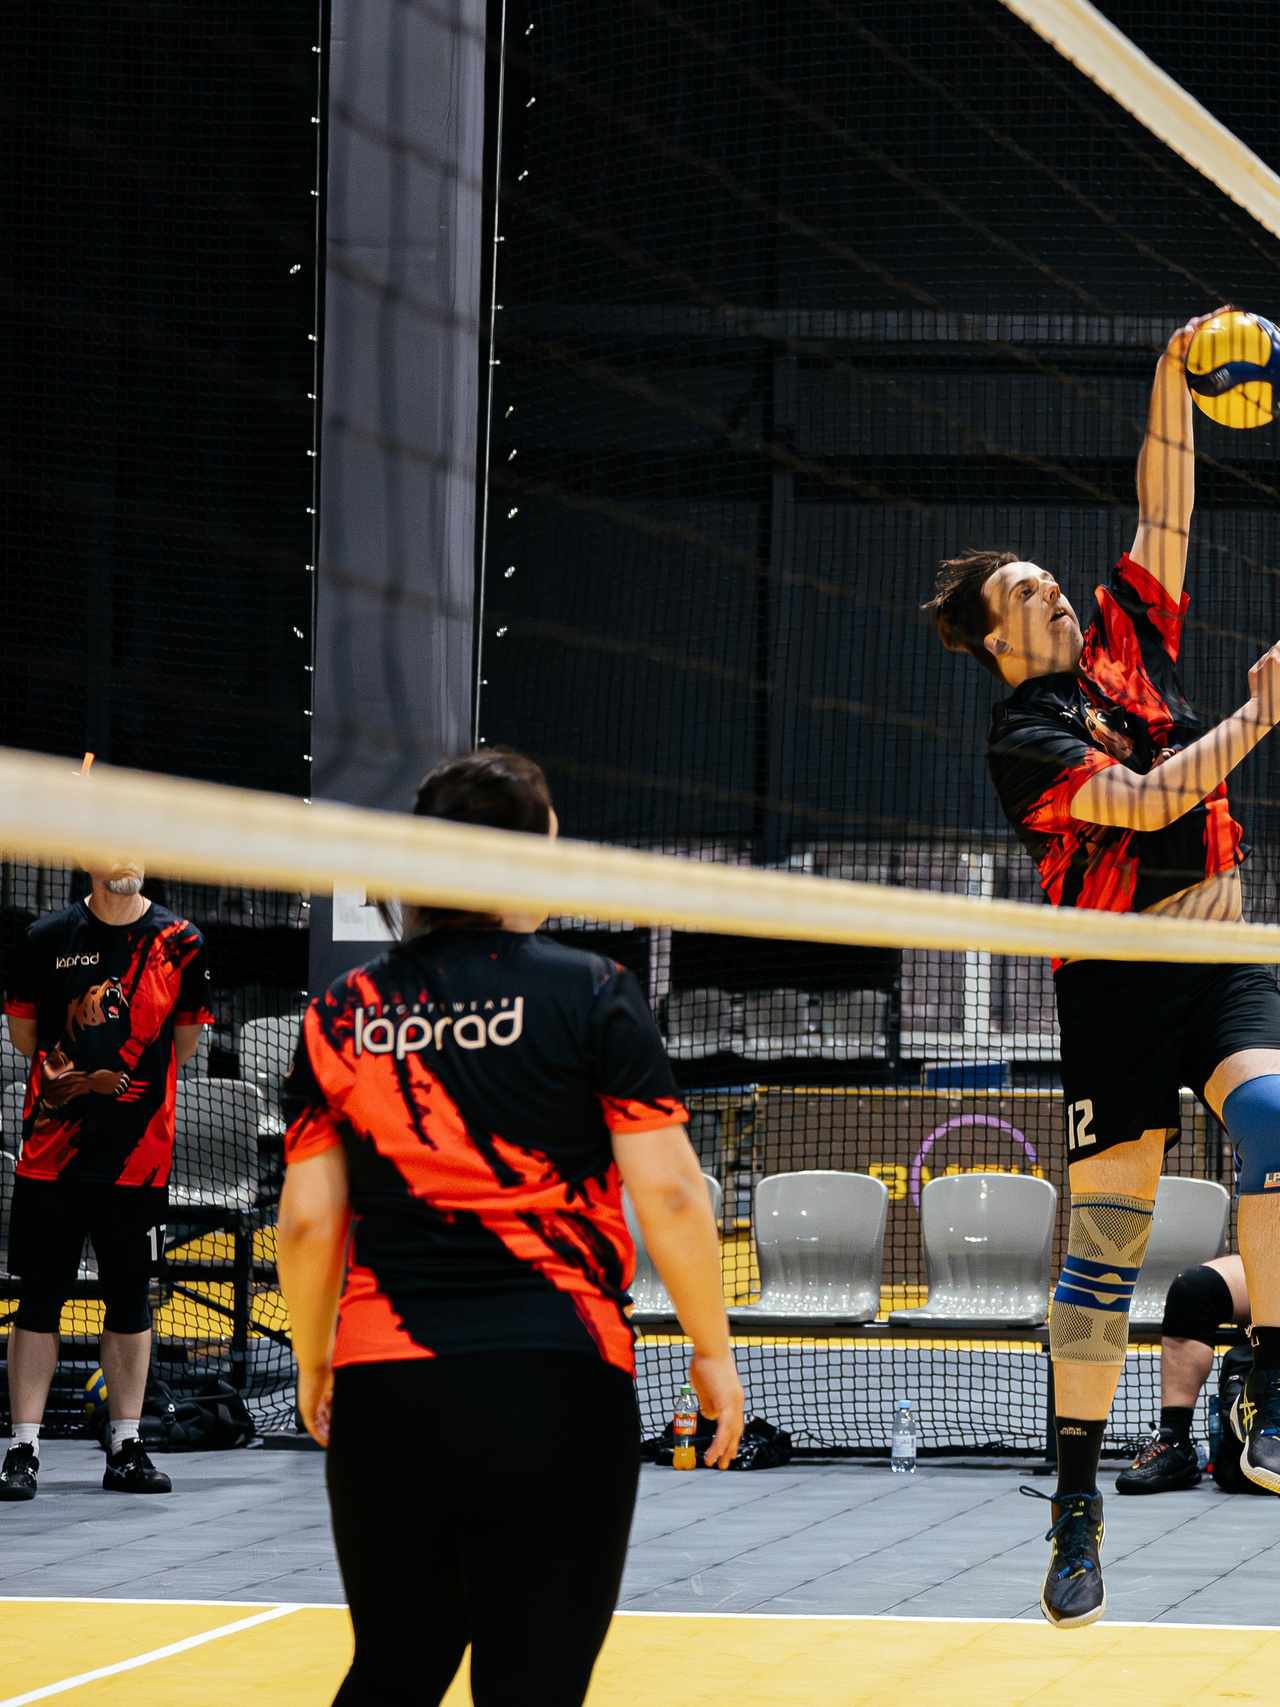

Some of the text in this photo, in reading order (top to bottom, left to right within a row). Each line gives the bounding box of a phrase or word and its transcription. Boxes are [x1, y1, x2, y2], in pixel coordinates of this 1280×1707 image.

[56, 952, 100, 969] laprad
[354, 996, 524, 1060] laprad
[1067, 1098, 1097, 1151] 12
